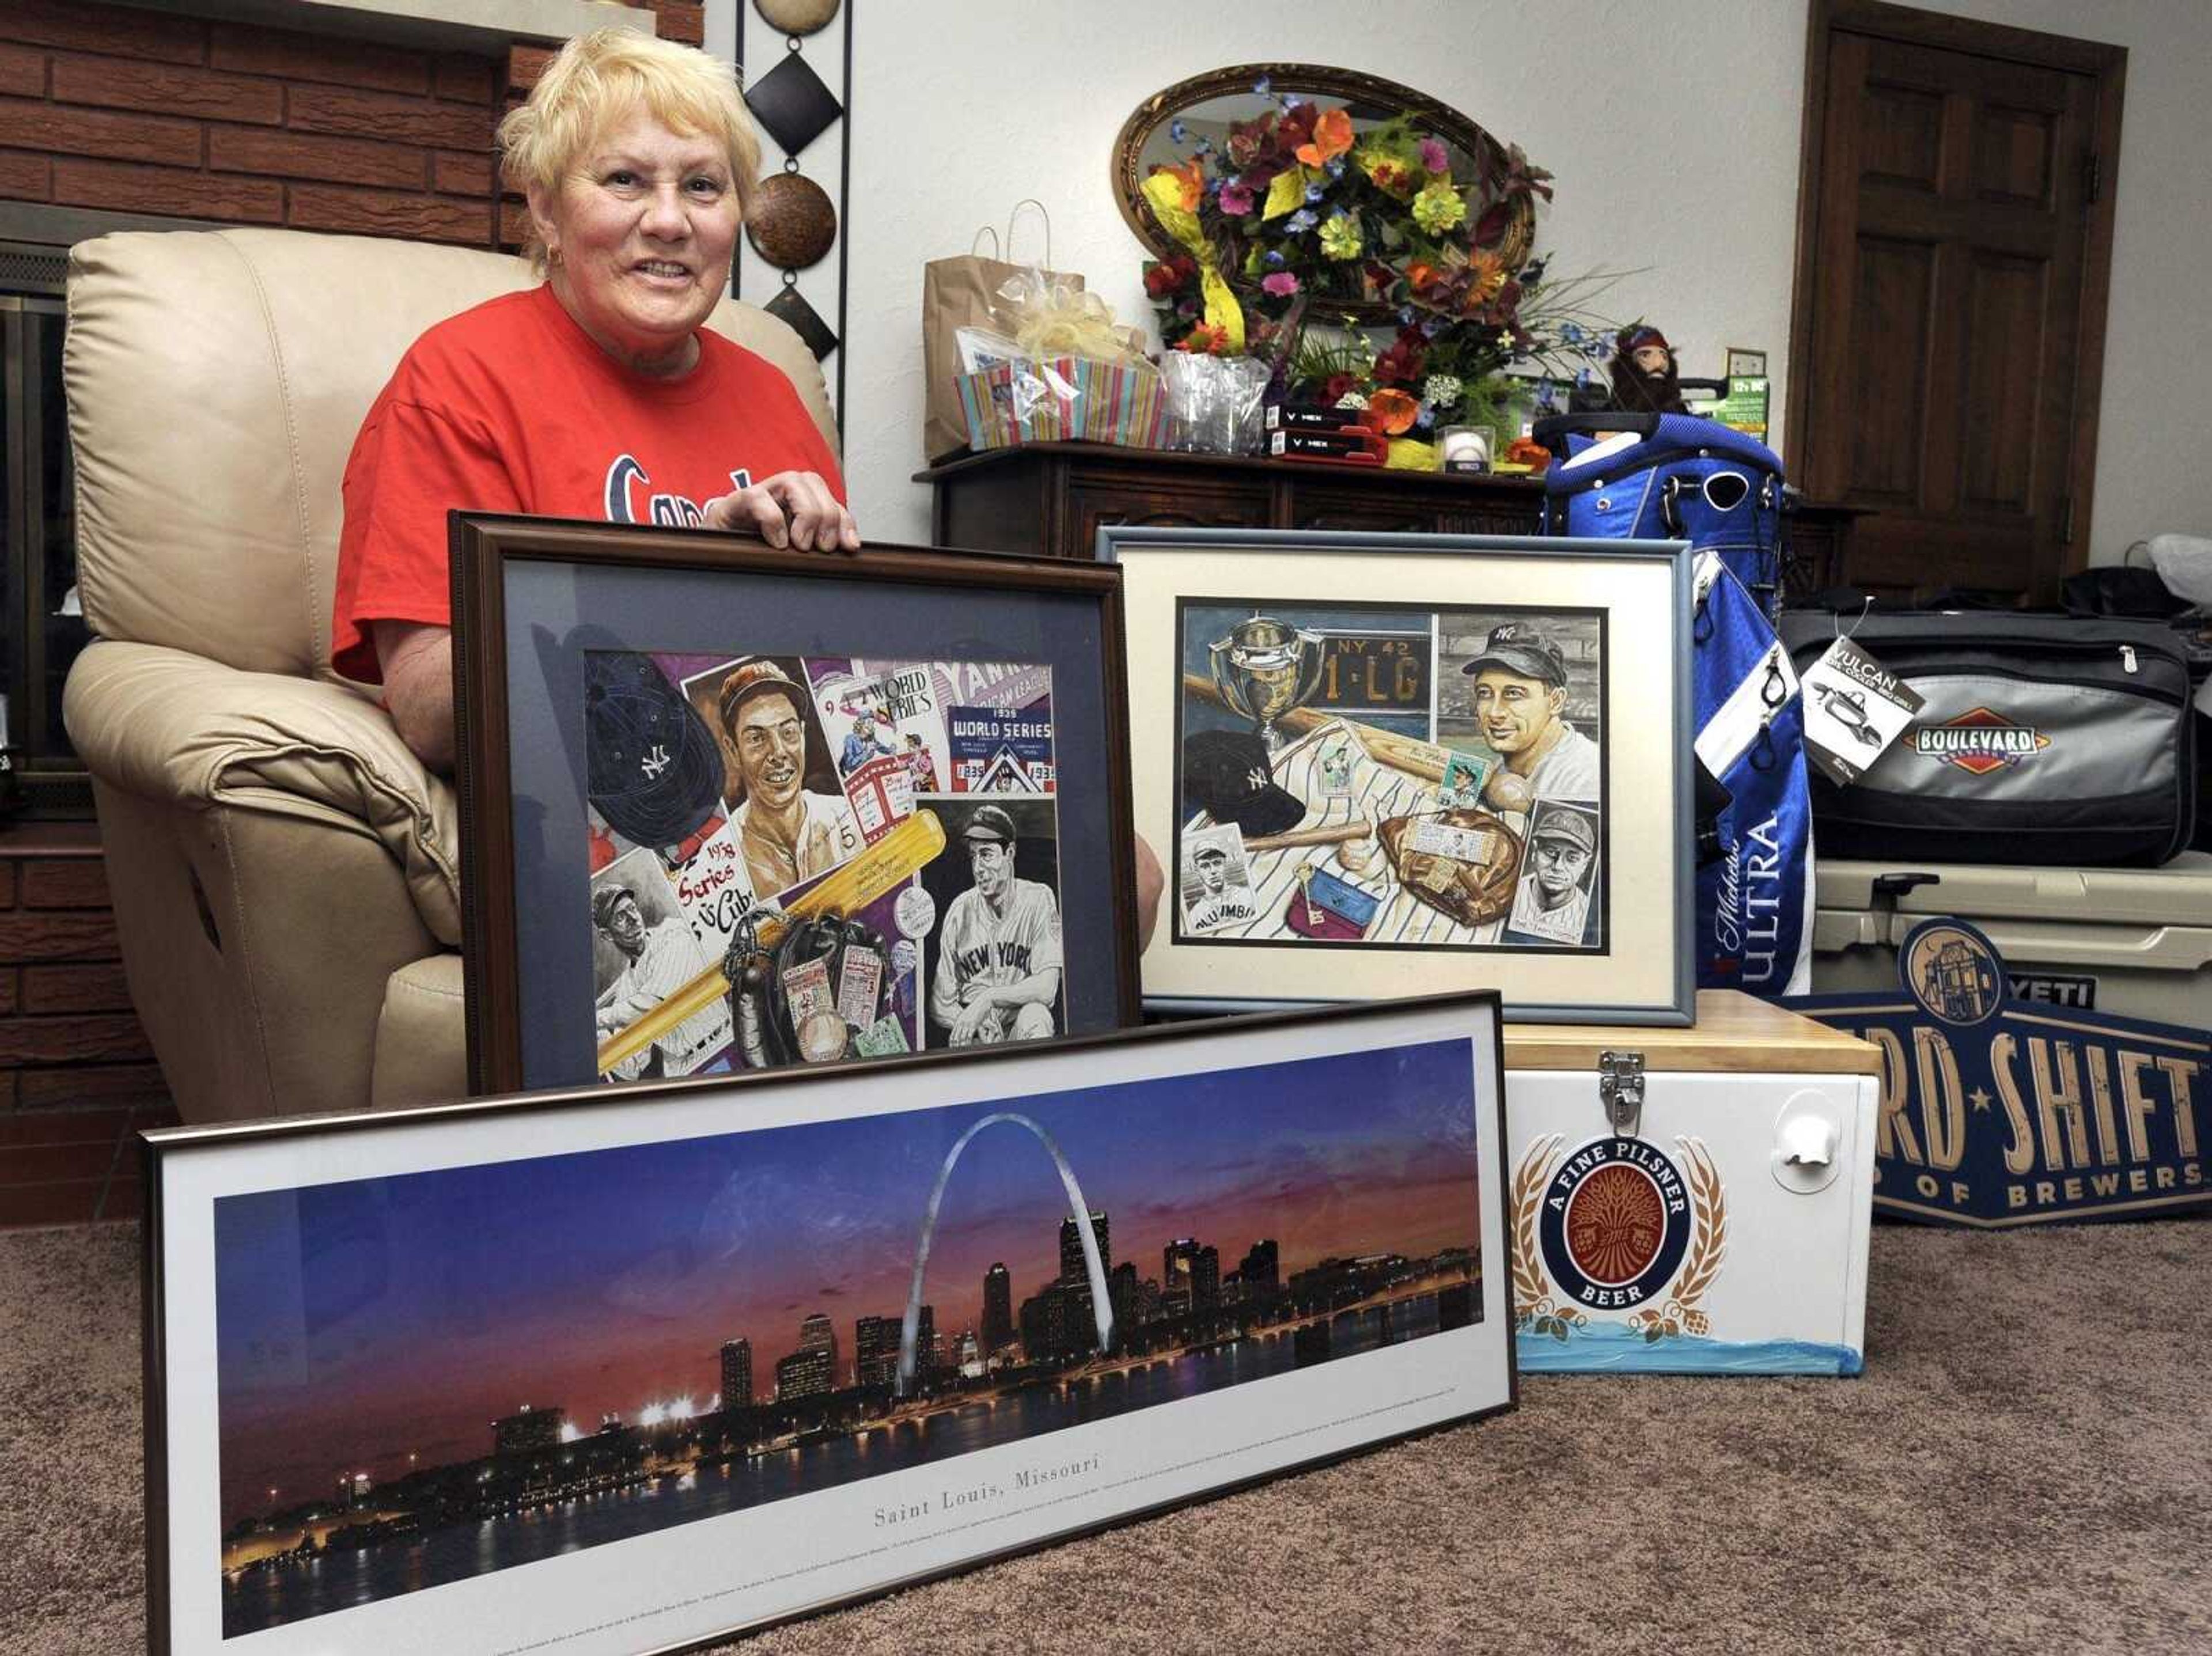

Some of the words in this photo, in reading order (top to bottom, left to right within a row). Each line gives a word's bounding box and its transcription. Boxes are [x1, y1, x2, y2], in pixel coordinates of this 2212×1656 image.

[869, 671, 927, 700] WORLD
[1834, 650, 1897, 691] VULCAN
[877, 693, 932, 723] SERIES
[954, 721, 999, 737] WORLD
[1004, 723, 1052, 738] SERIES
[1921, 729, 2031, 751] BOULEVARD
[641, 744, 670, 780] NY
[840, 825, 856, 850] 5
[679, 865, 734, 907] Series
[1742, 814, 1781, 983] ULTRA
[959, 944, 990, 980] NEW
[997, 941, 1032, 976] YORK
[2009, 979, 2088, 1007] YETI
[1991, 1032, 2199, 1174] SHIFT
[1550, 1196, 1565, 1211] A
[1558, 1146, 1607, 1190] FINE
[1616, 1143, 1685, 1215] PILSNER
[1917, 1174, 1969, 1205] OF
[2008, 1164, 2202, 1208] BREWERS
[1580, 1285, 1643, 1306] BEER
[874, 1501, 930, 1528] Saint
[942, 1482, 1004, 1509] Louis,
[1016, 1452, 1099, 1491] Missouri
